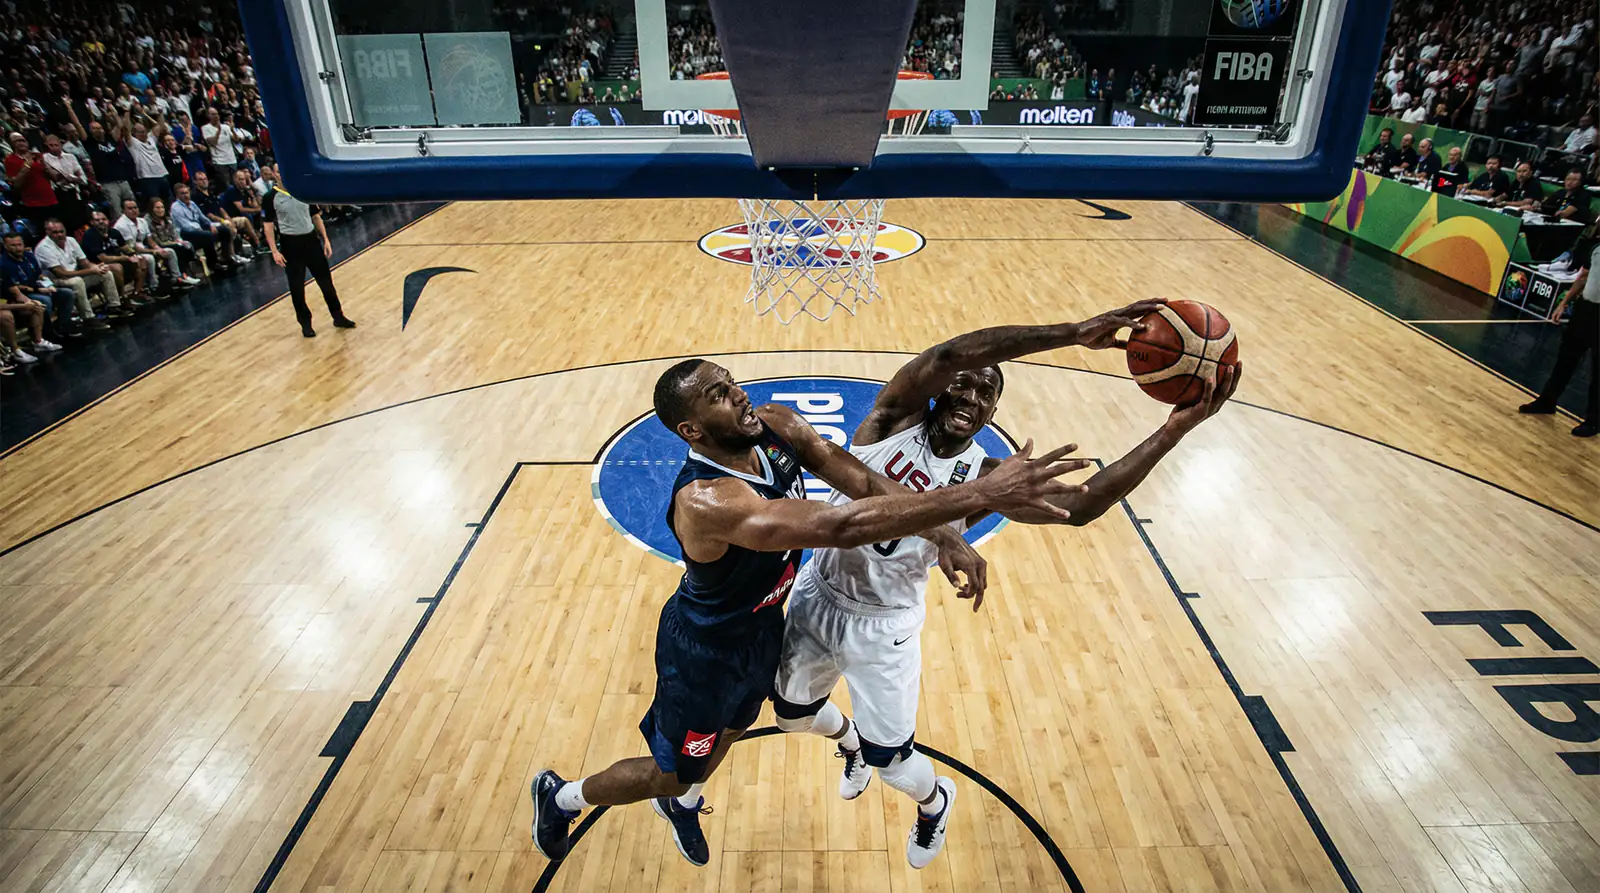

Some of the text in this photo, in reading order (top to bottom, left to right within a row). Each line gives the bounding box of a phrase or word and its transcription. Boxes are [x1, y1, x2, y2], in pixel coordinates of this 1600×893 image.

[1213, 52, 1274, 80] FIBA
[1019, 106, 1094, 124] molten
[1532, 280, 1553, 298] FIBA
[884, 449, 944, 493] US
